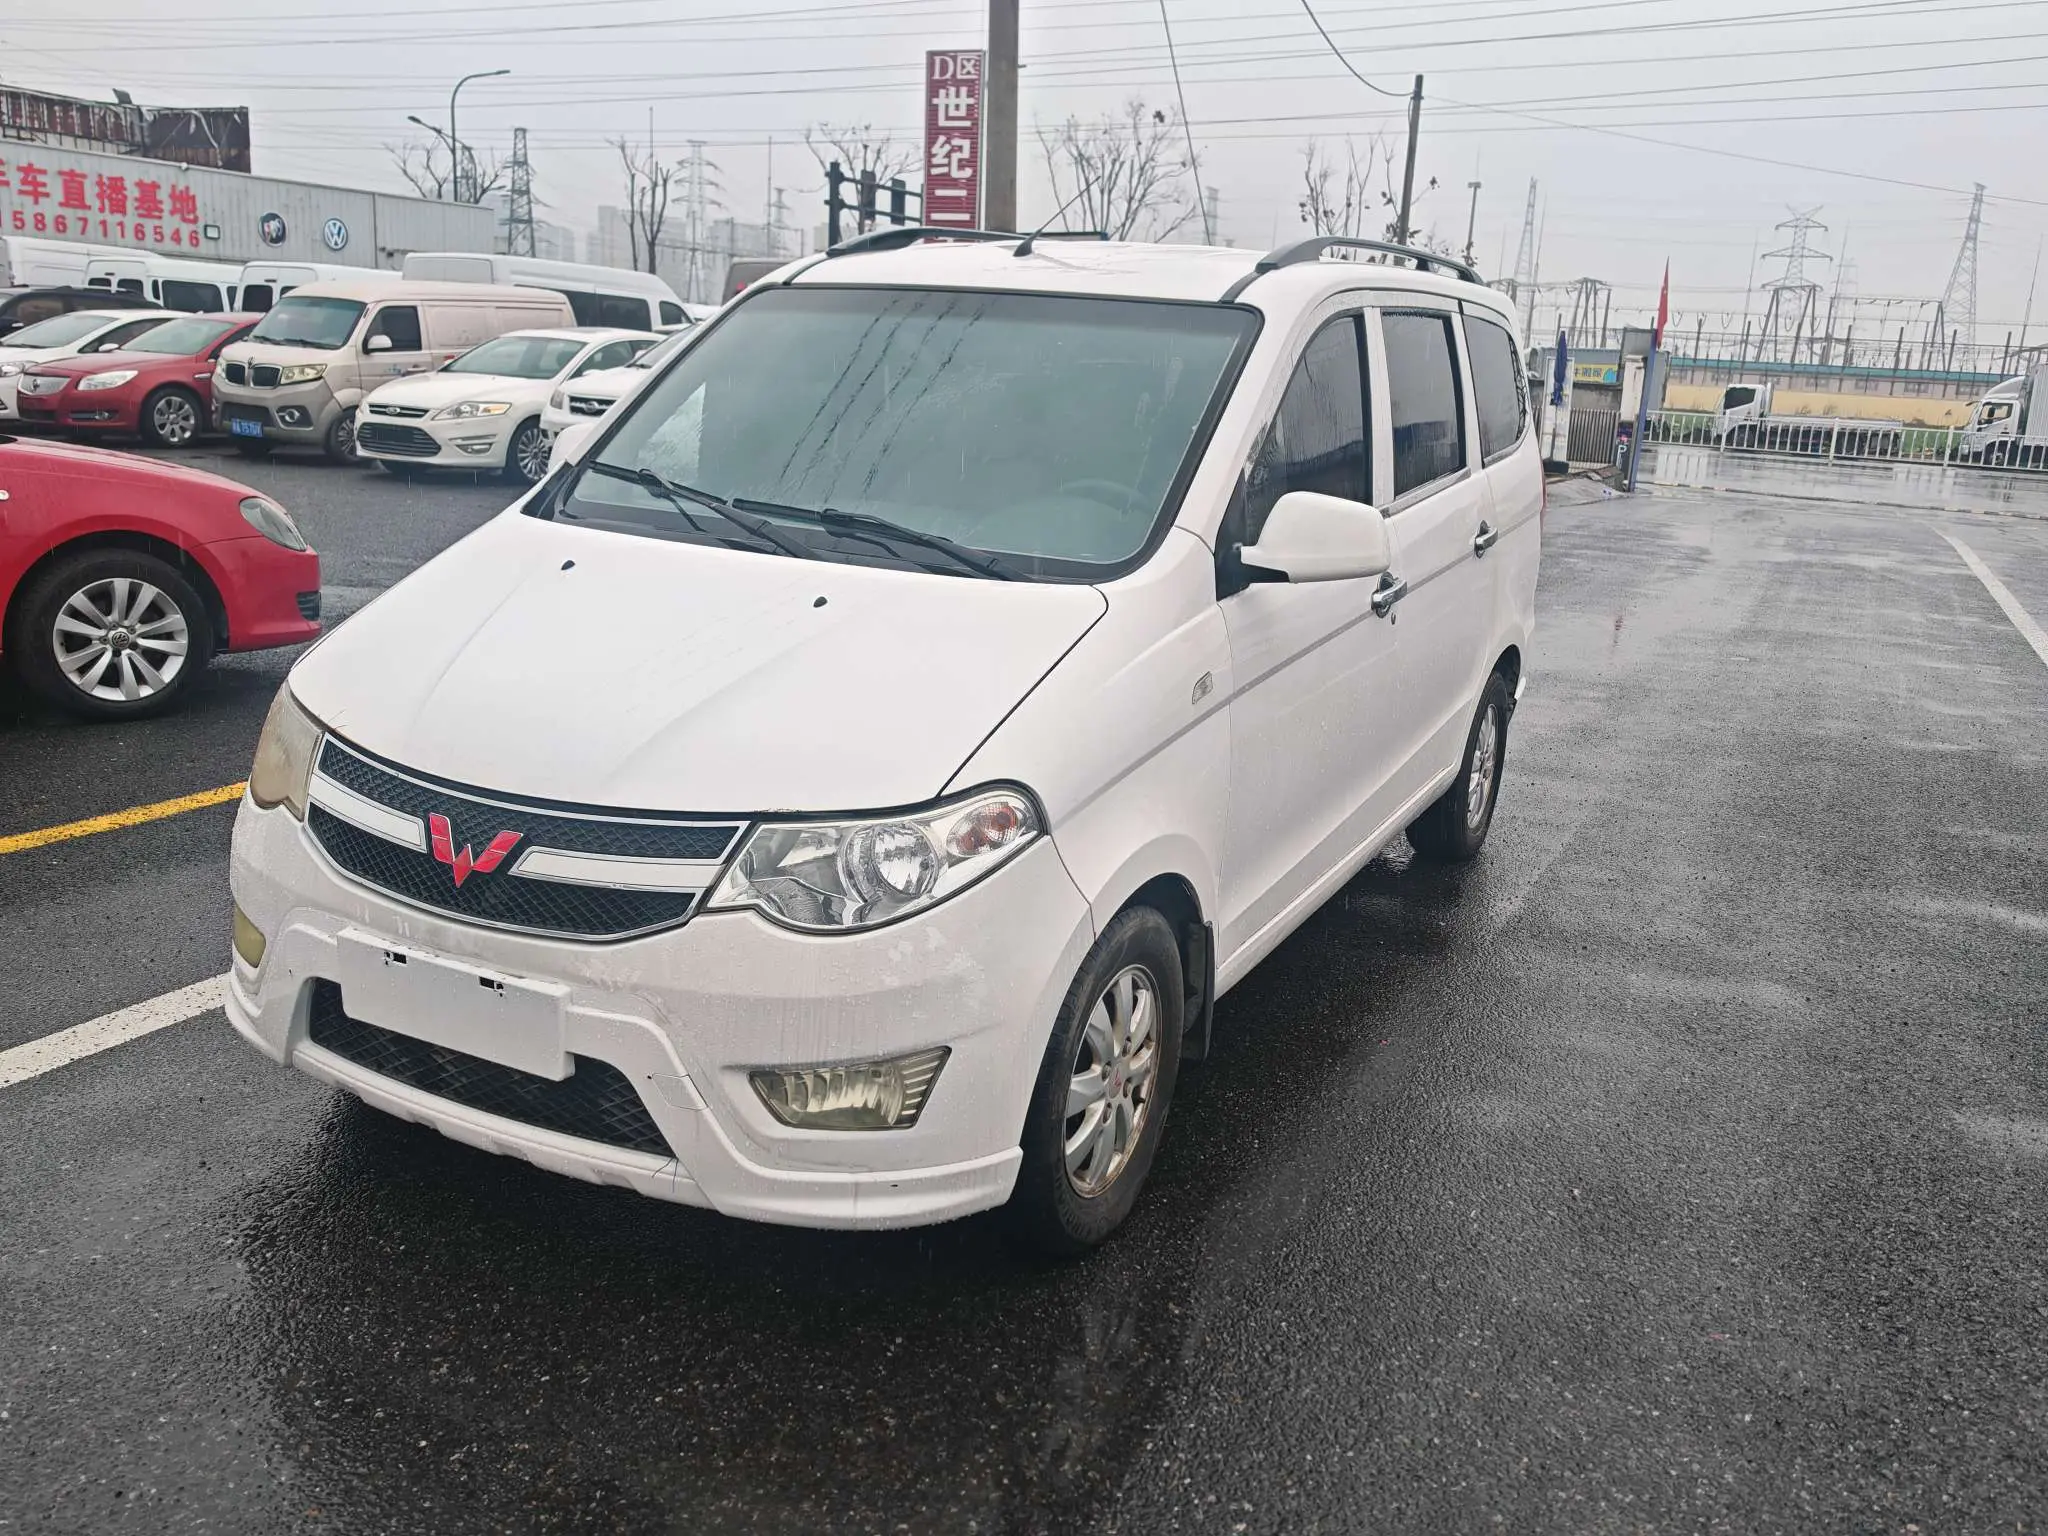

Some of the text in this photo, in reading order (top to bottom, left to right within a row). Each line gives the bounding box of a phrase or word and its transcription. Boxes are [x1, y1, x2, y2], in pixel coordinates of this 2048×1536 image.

[932, 53, 979, 80] D区
[930, 86, 976, 243] 世纪二
[0, 209, 201, 248] 5867116546
